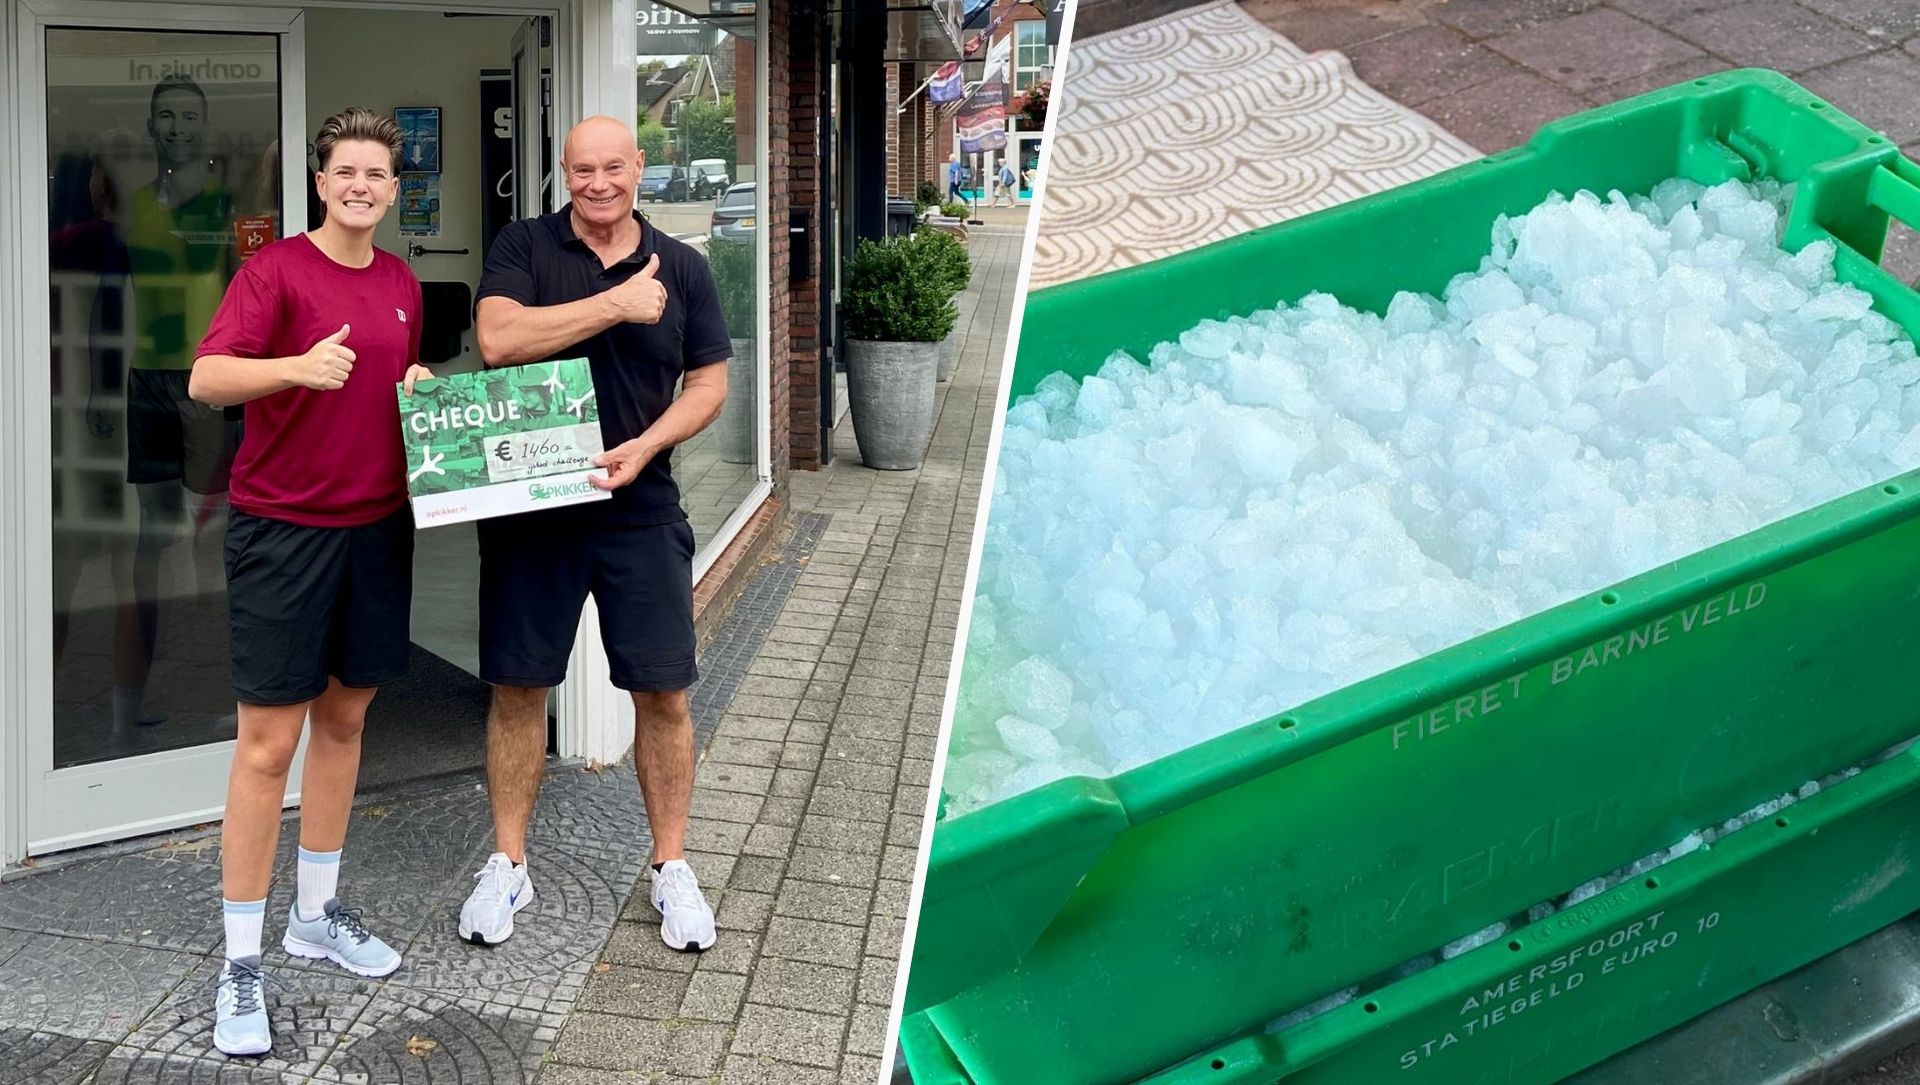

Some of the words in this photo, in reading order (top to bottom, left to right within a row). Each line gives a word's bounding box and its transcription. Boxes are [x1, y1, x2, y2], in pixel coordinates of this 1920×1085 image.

[411, 399, 522, 434] CHEQUE
[1391, 671, 1529, 751] FIERET
[1551, 582, 1767, 686] BARNEVELD
[1400, 972, 1585, 1070] STATIEGELD
[1601, 931, 1678, 975] EURO
[1697, 911, 1721, 934] 10
[1459, 911, 1665, 1016] AMERSFOORT
